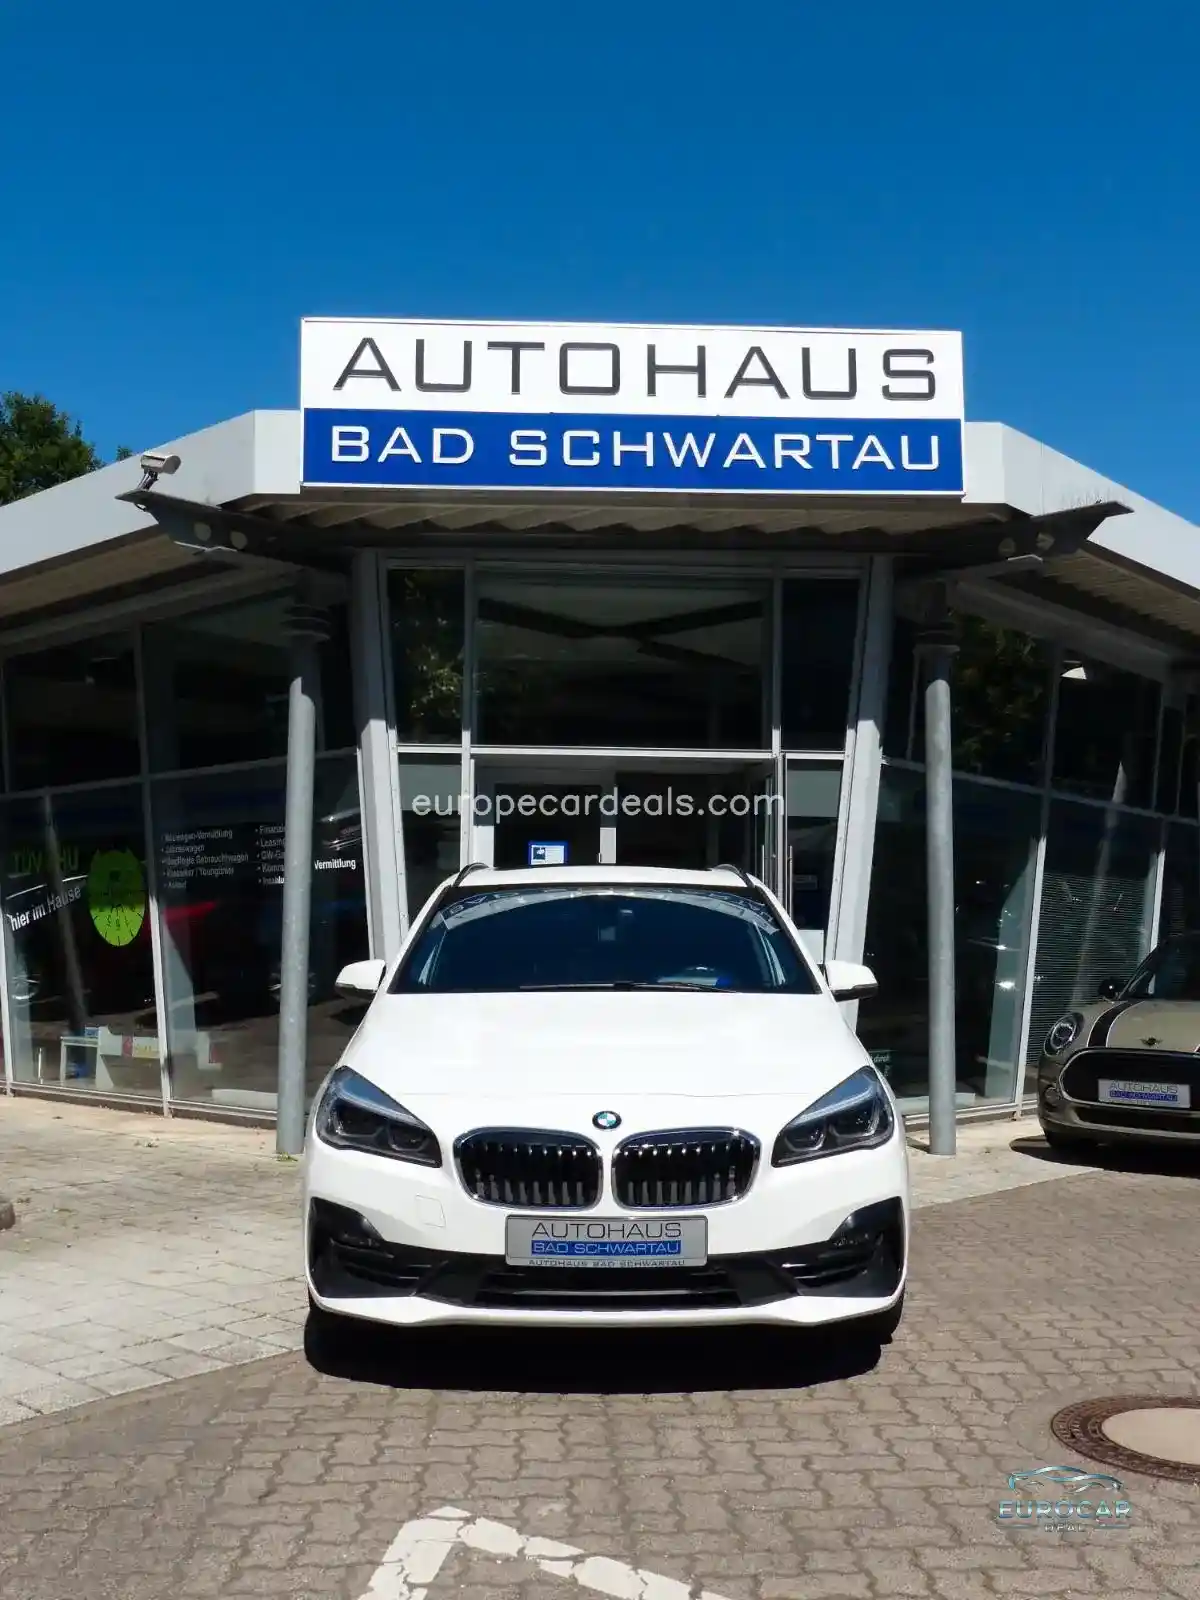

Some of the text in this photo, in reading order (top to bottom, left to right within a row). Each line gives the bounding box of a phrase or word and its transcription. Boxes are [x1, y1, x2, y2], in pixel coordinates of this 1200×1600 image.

[333, 337, 936, 402] AUTOHAUS
[331, 425, 941, 471] BAD SCHWARTAU
[10, 885, 82, 931] hier im Hause
[1109, 1080, 1179, 1095] AUTOHAUS
[531, 1222, 682, 1239] AUTOHAUS
[532, 1242, 680, 1255] BAD SCHWARTAU
[529, 1259, 685, 1268] AUTOHAUS BAD SCHWARTAU
